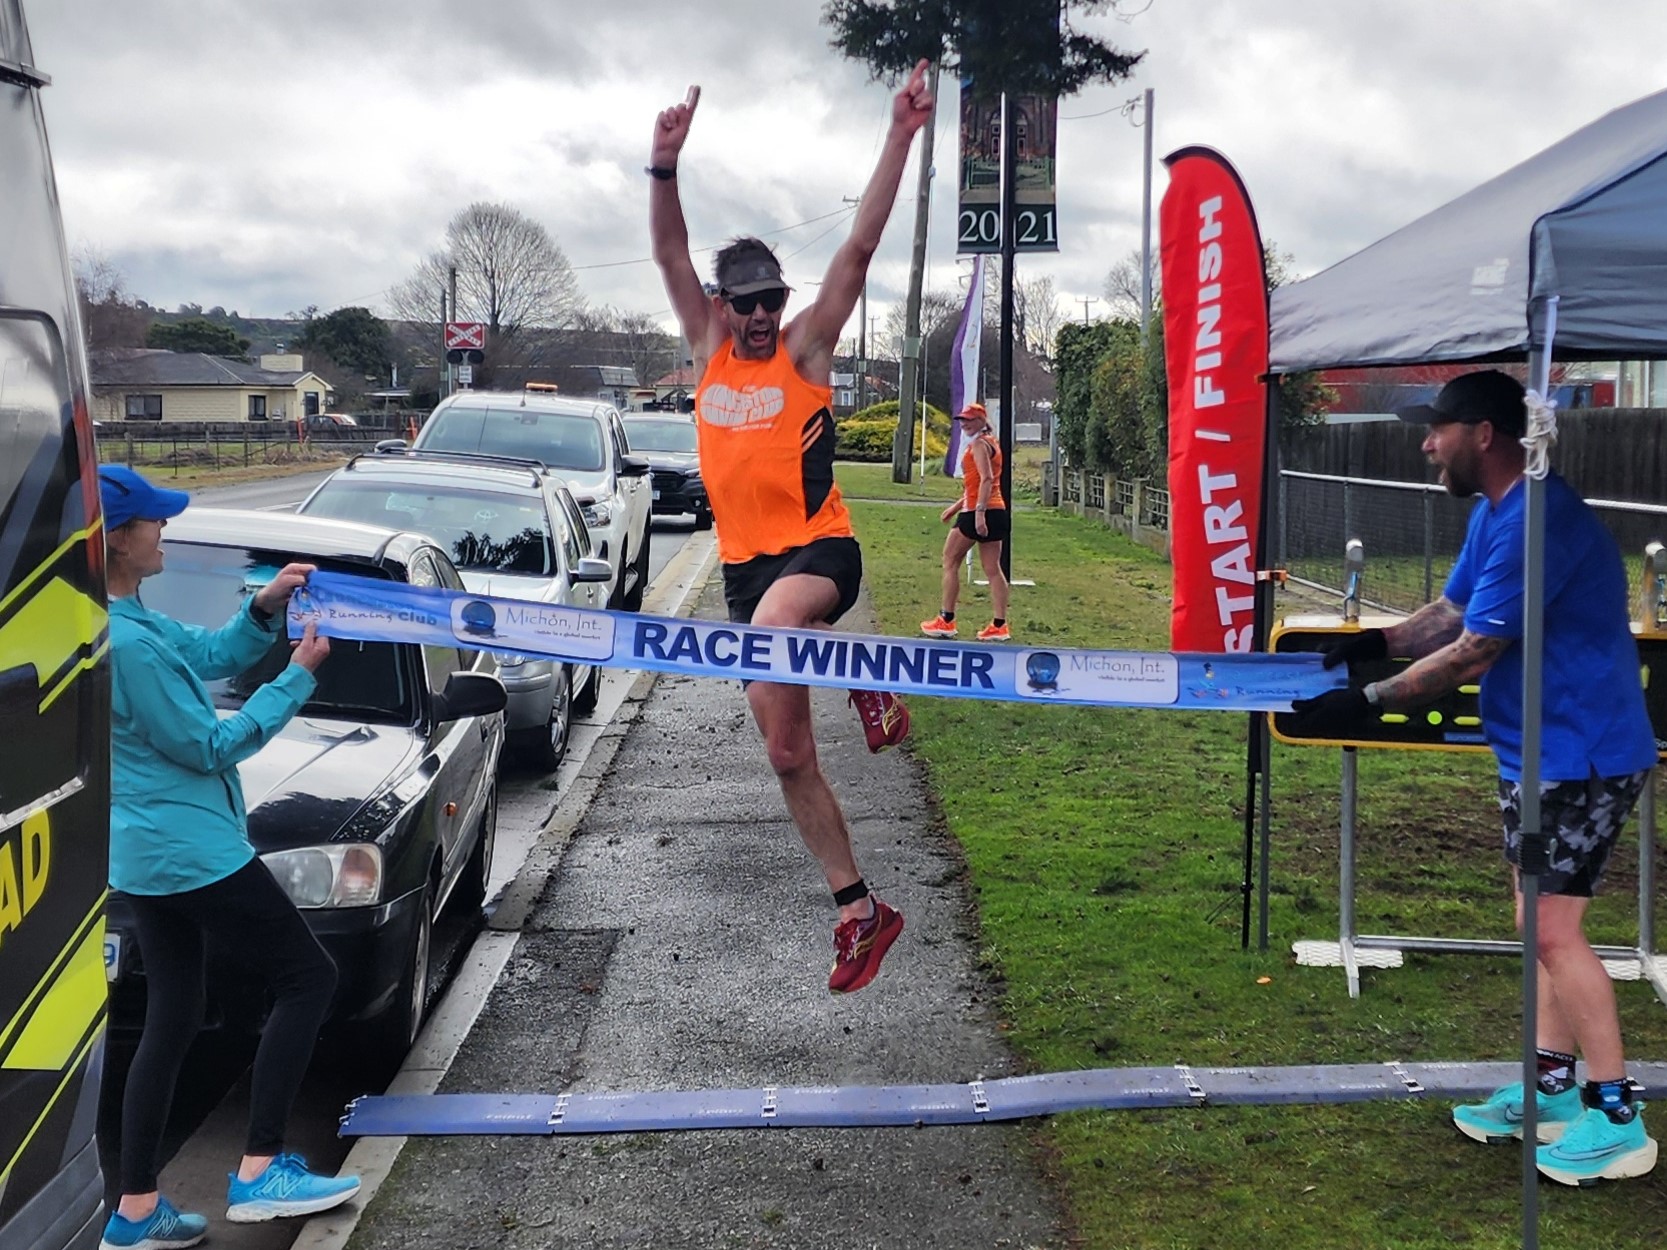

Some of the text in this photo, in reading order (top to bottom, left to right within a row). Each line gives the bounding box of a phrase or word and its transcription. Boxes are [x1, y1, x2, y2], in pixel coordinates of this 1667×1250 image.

[959, 210, 1056, 242] 20 21
[1194, 195, 1226, 410] FINISH
[329, 608, 438, 626] Running Club
[577, 612, 603, 631] Int.
[633, 621, 995, 689] RACE WINNER
[1070, 654, 1165, 675] Michon, Int.
[1235, 685, 1300, 698] Running
